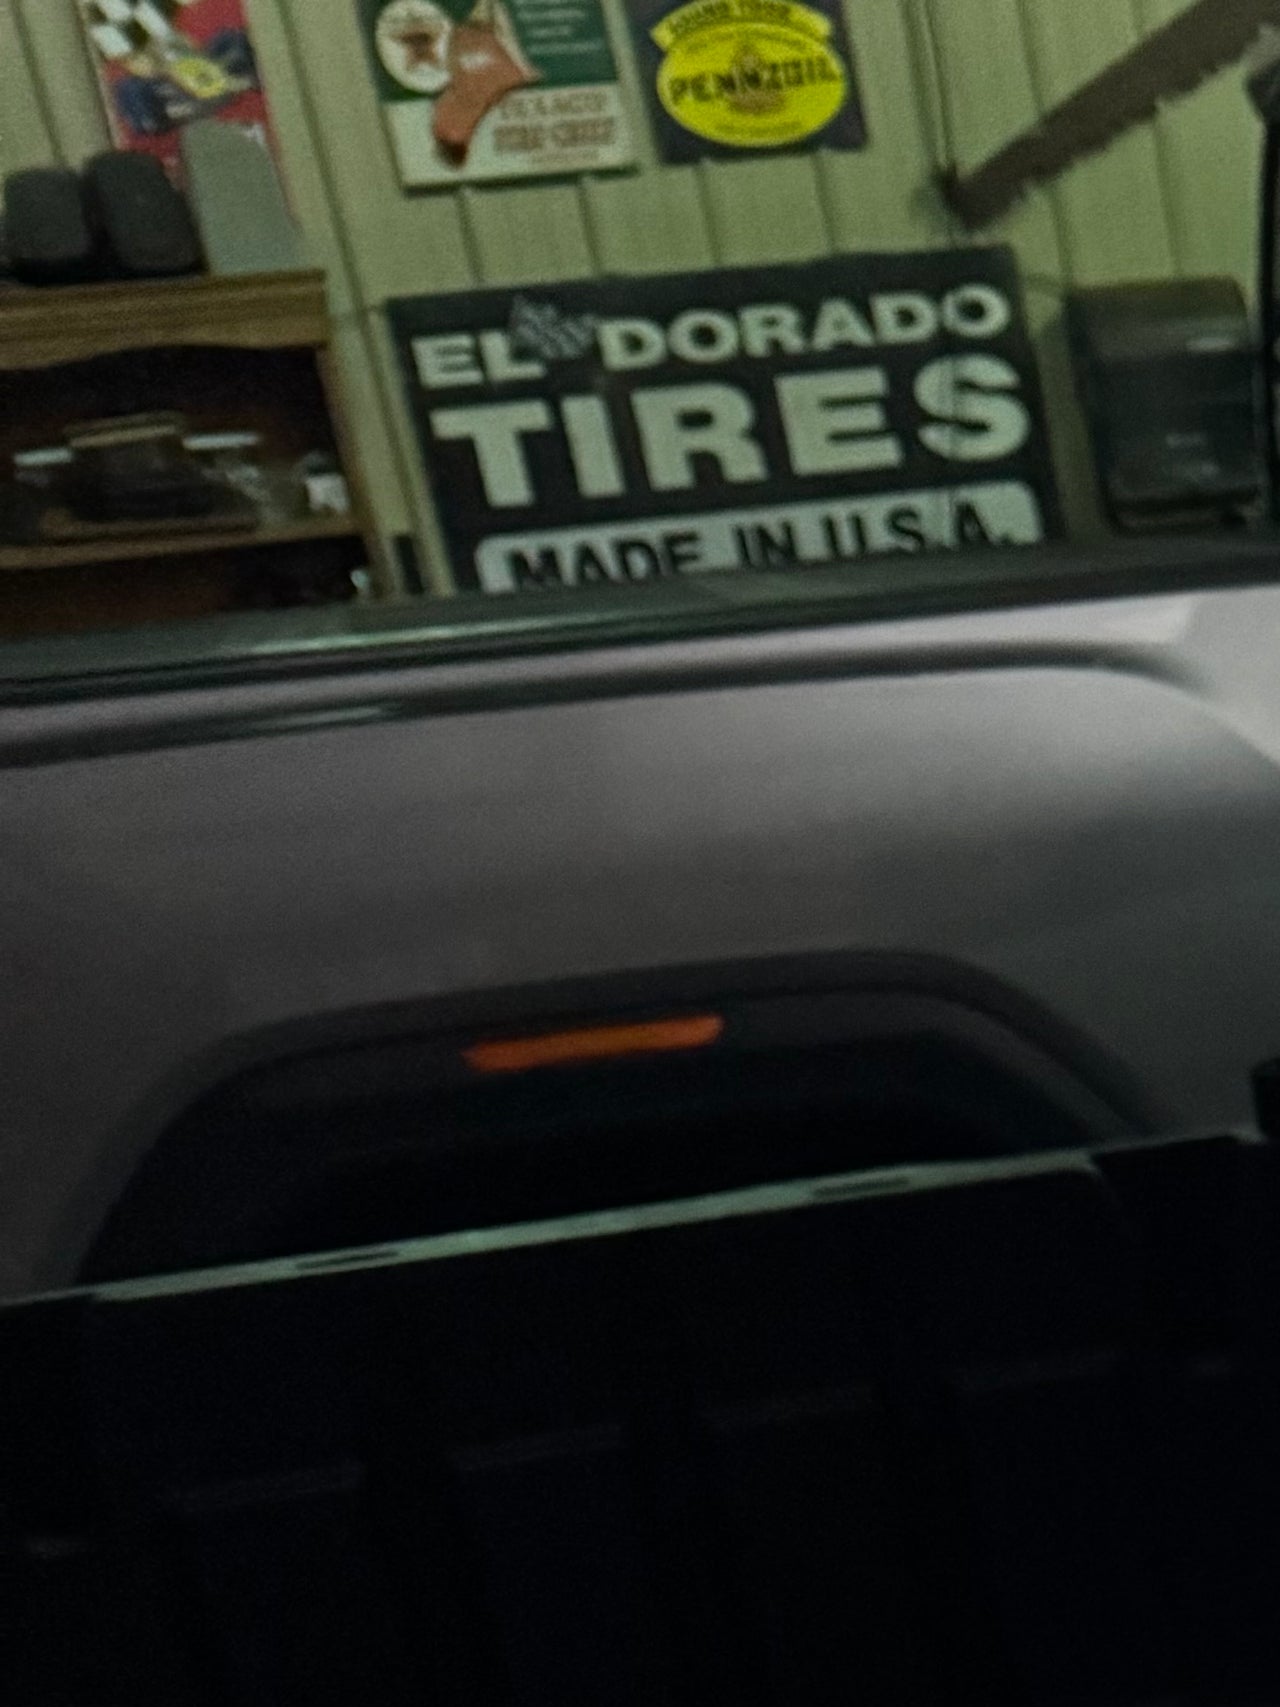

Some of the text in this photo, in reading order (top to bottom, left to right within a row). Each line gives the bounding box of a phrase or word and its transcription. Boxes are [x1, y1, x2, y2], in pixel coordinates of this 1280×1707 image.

[409, 282, 1011, 390] EL DORADO
[428, 352, 1031, 510] TIRES
[506, 529, 701, 586] MADE
[734, 518, 796, 568] IN
